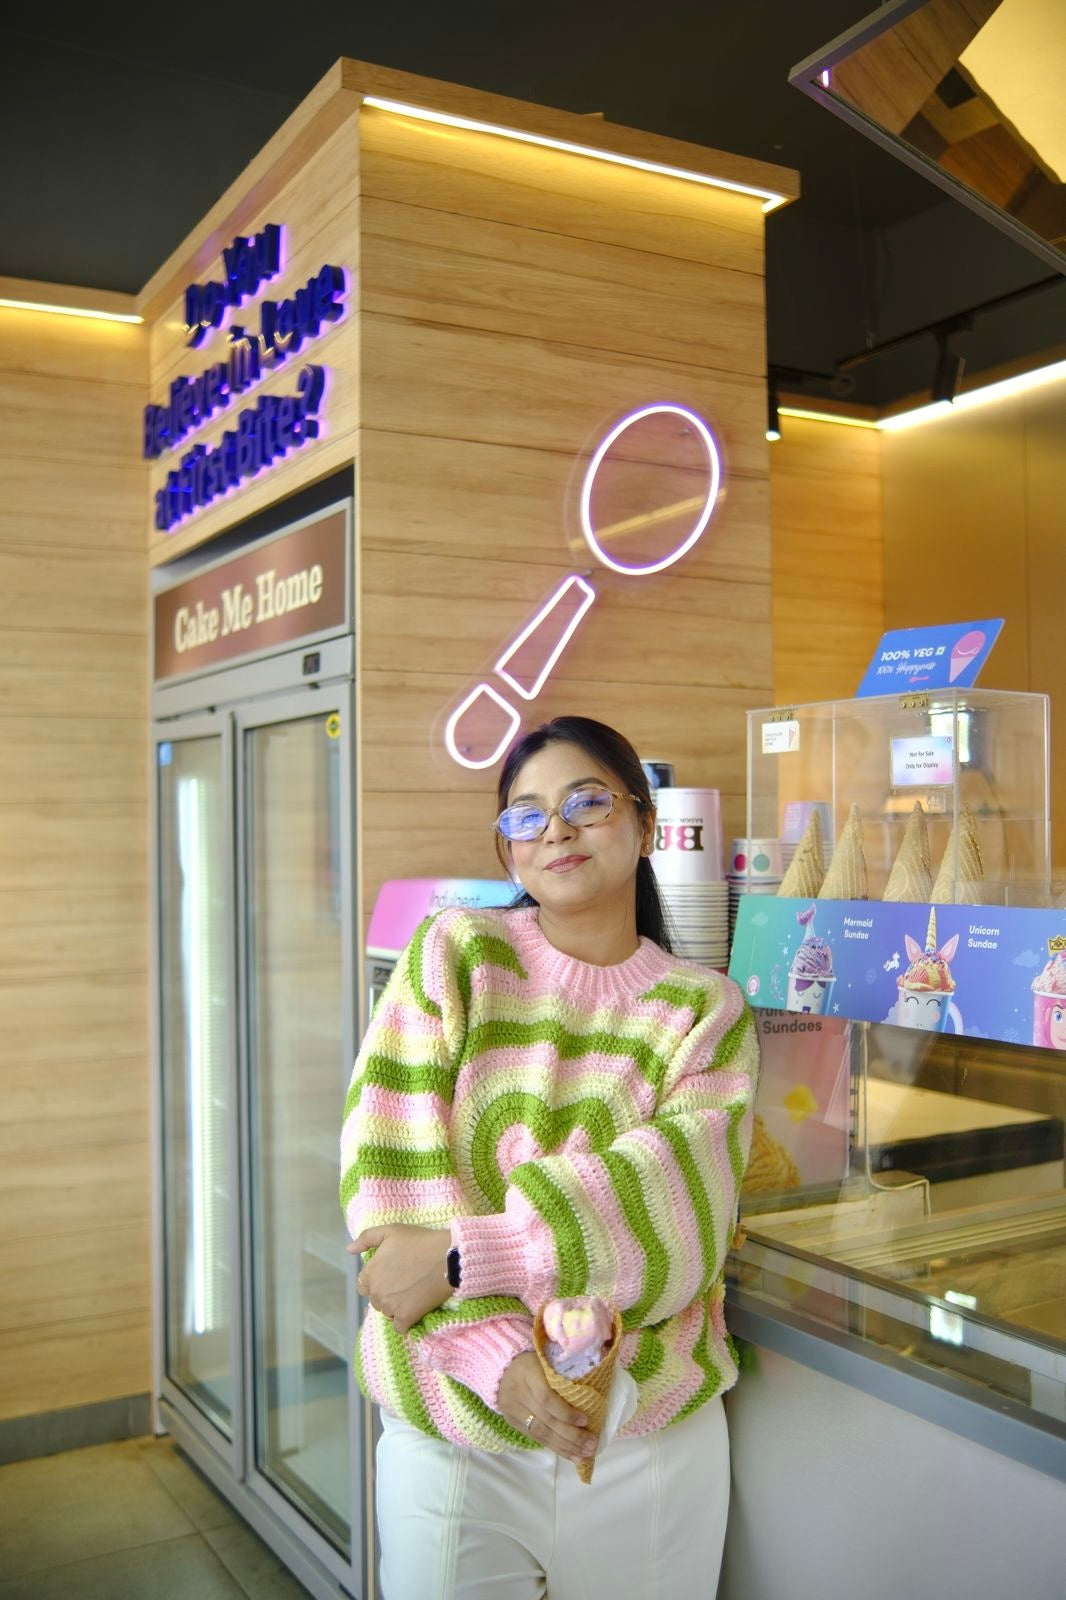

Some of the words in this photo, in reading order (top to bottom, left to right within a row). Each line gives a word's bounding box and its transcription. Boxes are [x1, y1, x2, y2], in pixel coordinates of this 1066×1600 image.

[144, 376, 231, 460] Believe
[174, 600, 219, 653] Cake
[221, 584, 253, 636] Me
[255, 564, 323, 623] Home
[880, 650, 911, 662] 100%
[914, 647, 934, 658] VEG
[656, 825, 704, 851] BR
[843, 917, 873, 928] Mermaid
[844, 929, 869, 940] Sundae
[969, 925, 1000, 937] Unicorn
[967, 938, 998, 949] Sundae
[762, 1019, 822, 1034] Sundaes
